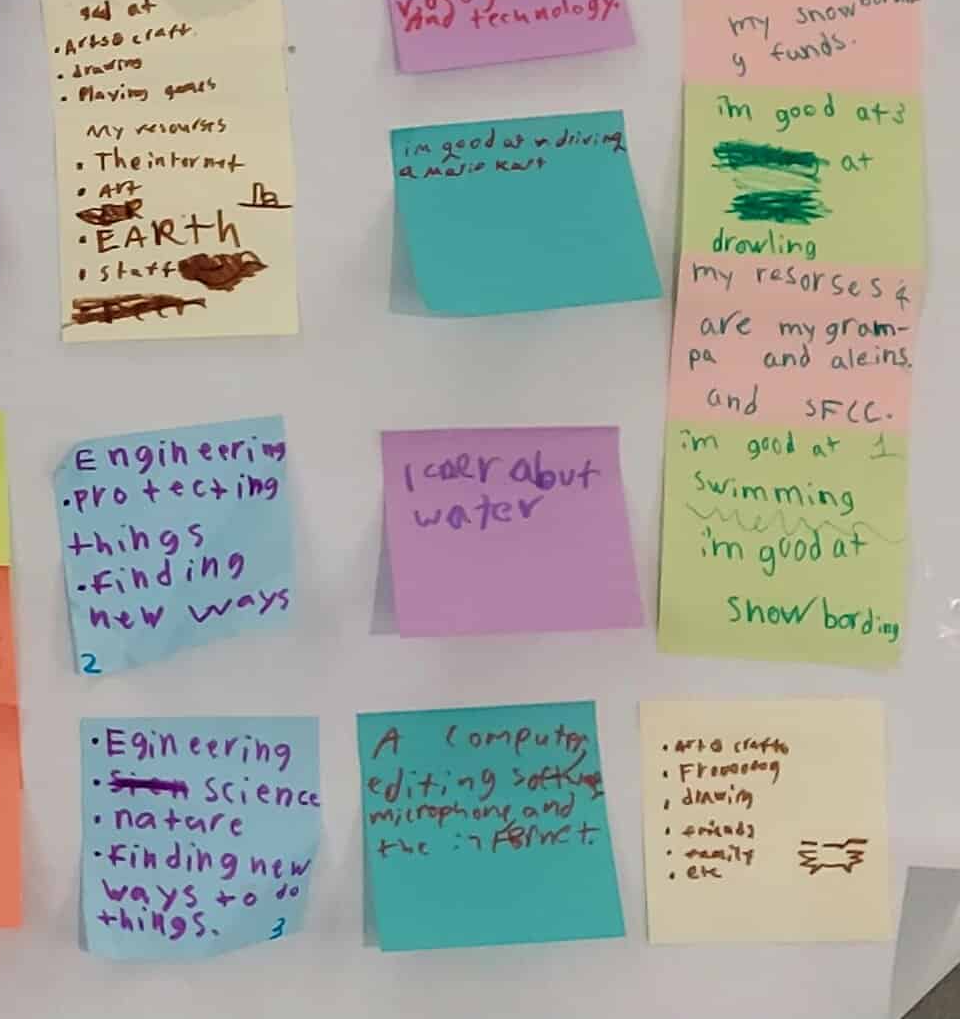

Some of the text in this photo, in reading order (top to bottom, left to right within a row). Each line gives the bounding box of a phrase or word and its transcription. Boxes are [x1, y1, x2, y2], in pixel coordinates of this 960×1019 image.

[729, 15, 769, 41] my
[776, 93, 890, 132] good at
[94, 147, 144, 171] The
[442, 130, 524, 162] good at
[841, 152, 873, 172] at
[693, 263, 733, 291] my
[700, 311, 815, 343] are my
[689, 345, 810, 373] pa and
[708, 384, 894, 423] and SFCC.
[747, 431, 795, 460] good
[813, 437, 840, 457] at
[405, 464, 414, 492] I
[694, 471, 854, 516] swimming
[414, 495, 544, 530] water
[67, 524, 204, 556] things
[759, 530, 868, 576] good at
[90, 588, 289, 629] new ways
[80, 653, 102, 674] 2
[106, 728, 291, 771] Egineering
[372, 727, 402, 758] A
[368, 768, 495, 802] editing
[523, 792, 574, 817] and
[251, 857, 310, 879] new
[102, 879, 299, 911] ways to do
[97, 906, 219, 941] things.
[270, 918, 285, 940] 3
